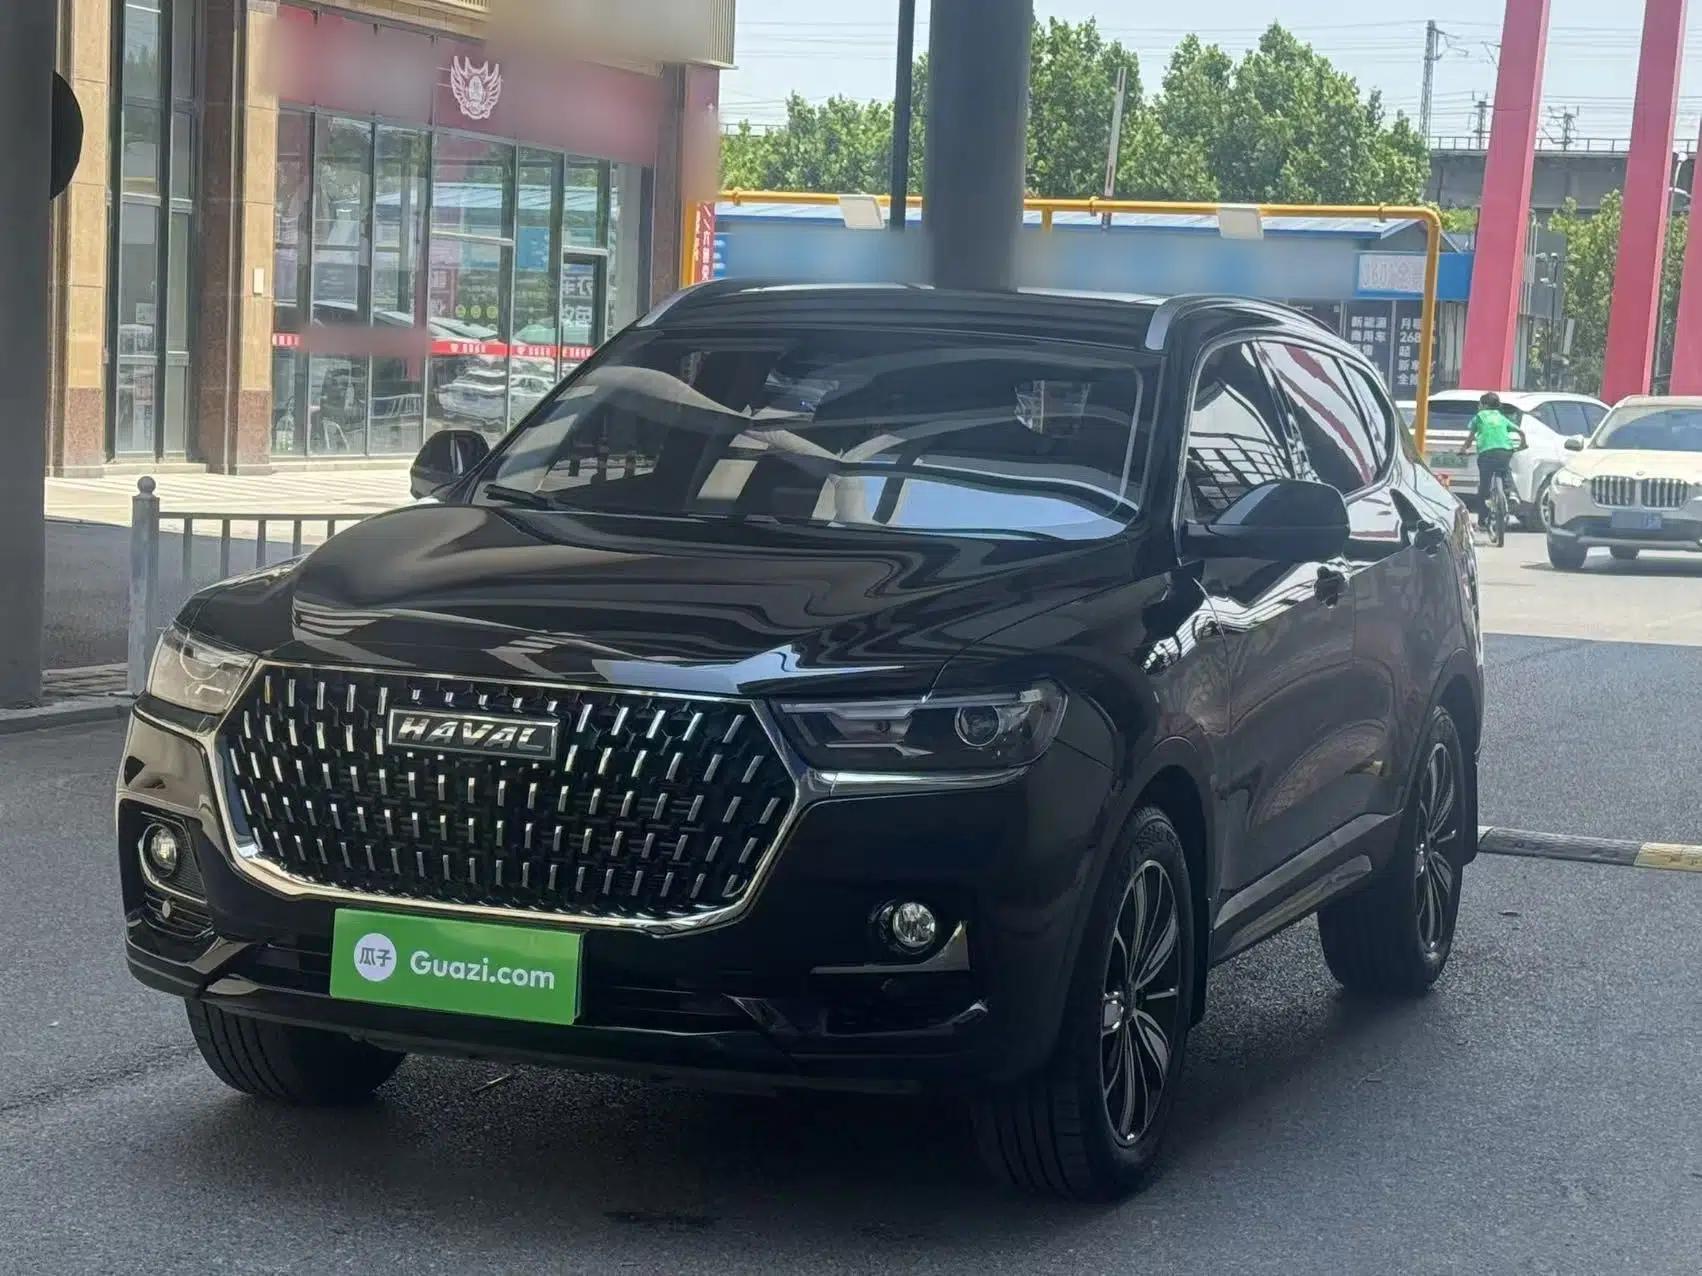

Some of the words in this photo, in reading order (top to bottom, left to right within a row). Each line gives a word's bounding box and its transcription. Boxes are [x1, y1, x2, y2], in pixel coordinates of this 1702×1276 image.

[397, 717, 545, 751] HAVAL
[359, 947, 392, 967] 瓜子
[410, 950, 555, 990] Guazi.com
